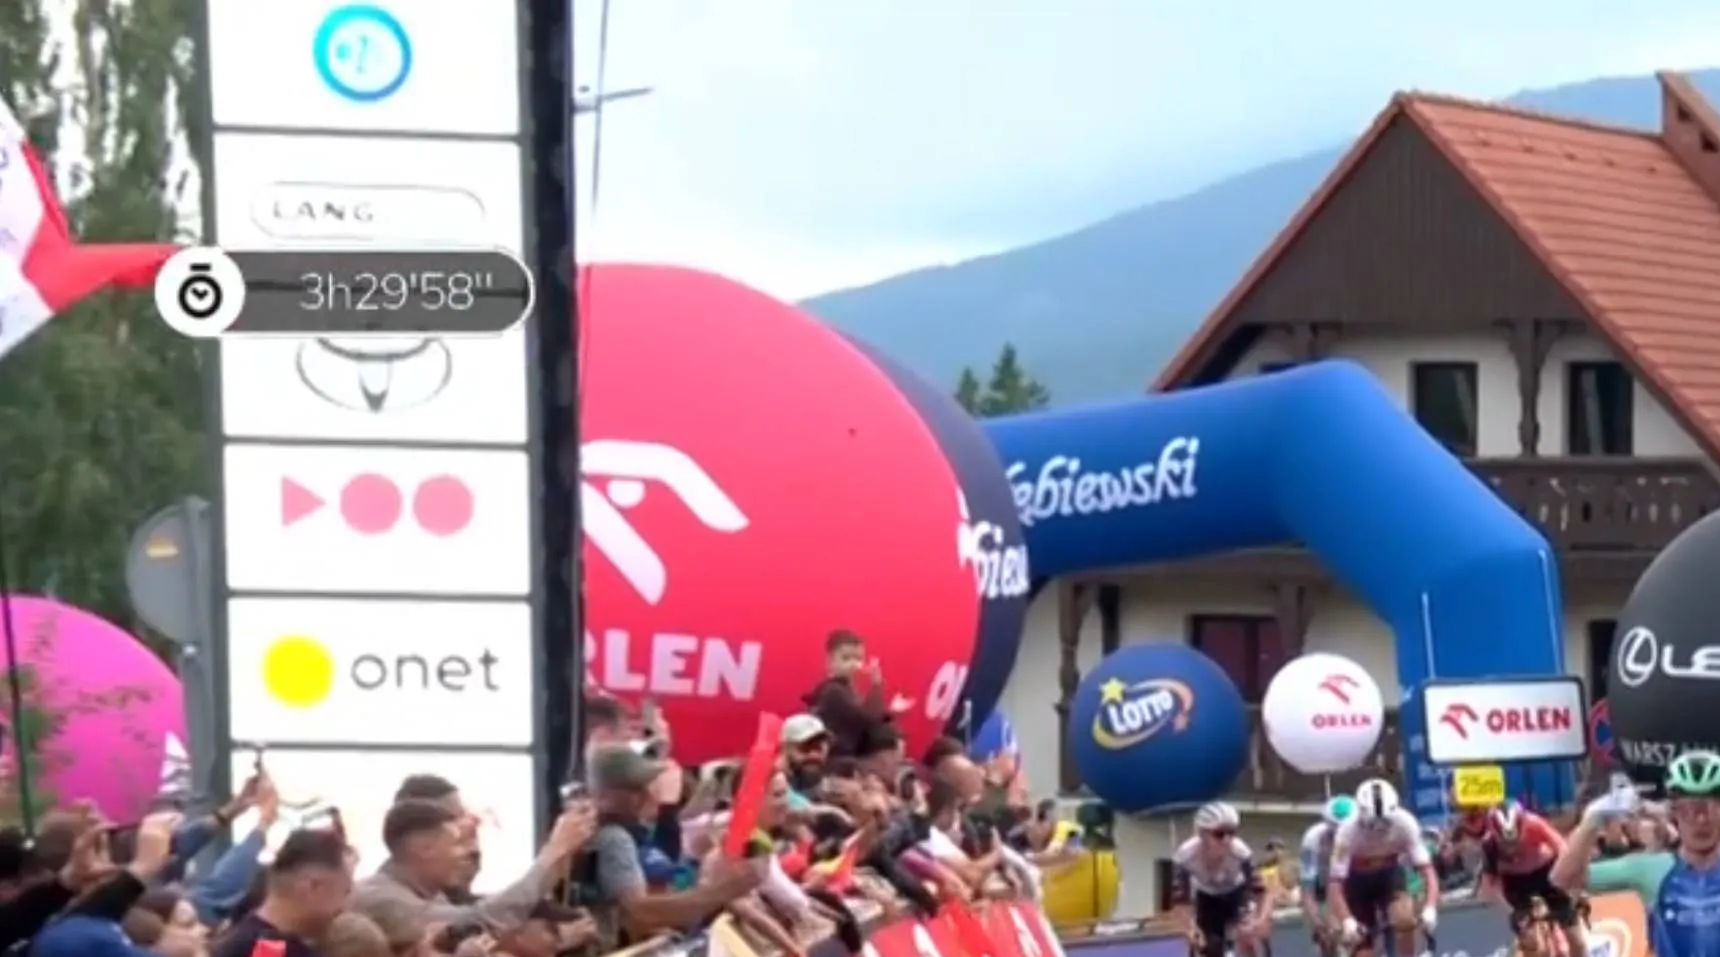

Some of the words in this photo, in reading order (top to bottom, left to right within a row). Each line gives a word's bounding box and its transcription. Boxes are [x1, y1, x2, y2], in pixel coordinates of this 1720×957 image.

[272, 200, 375, 223] LANG
[350, 647, 500, 692] onet
[1107, 689, 1174, 735] LOTTO
[1310, 712, 1372, 731] ORLEN
[1485, 706, 1572, 733] ORLEN
[1459, 774, 1501, 797] 25m
